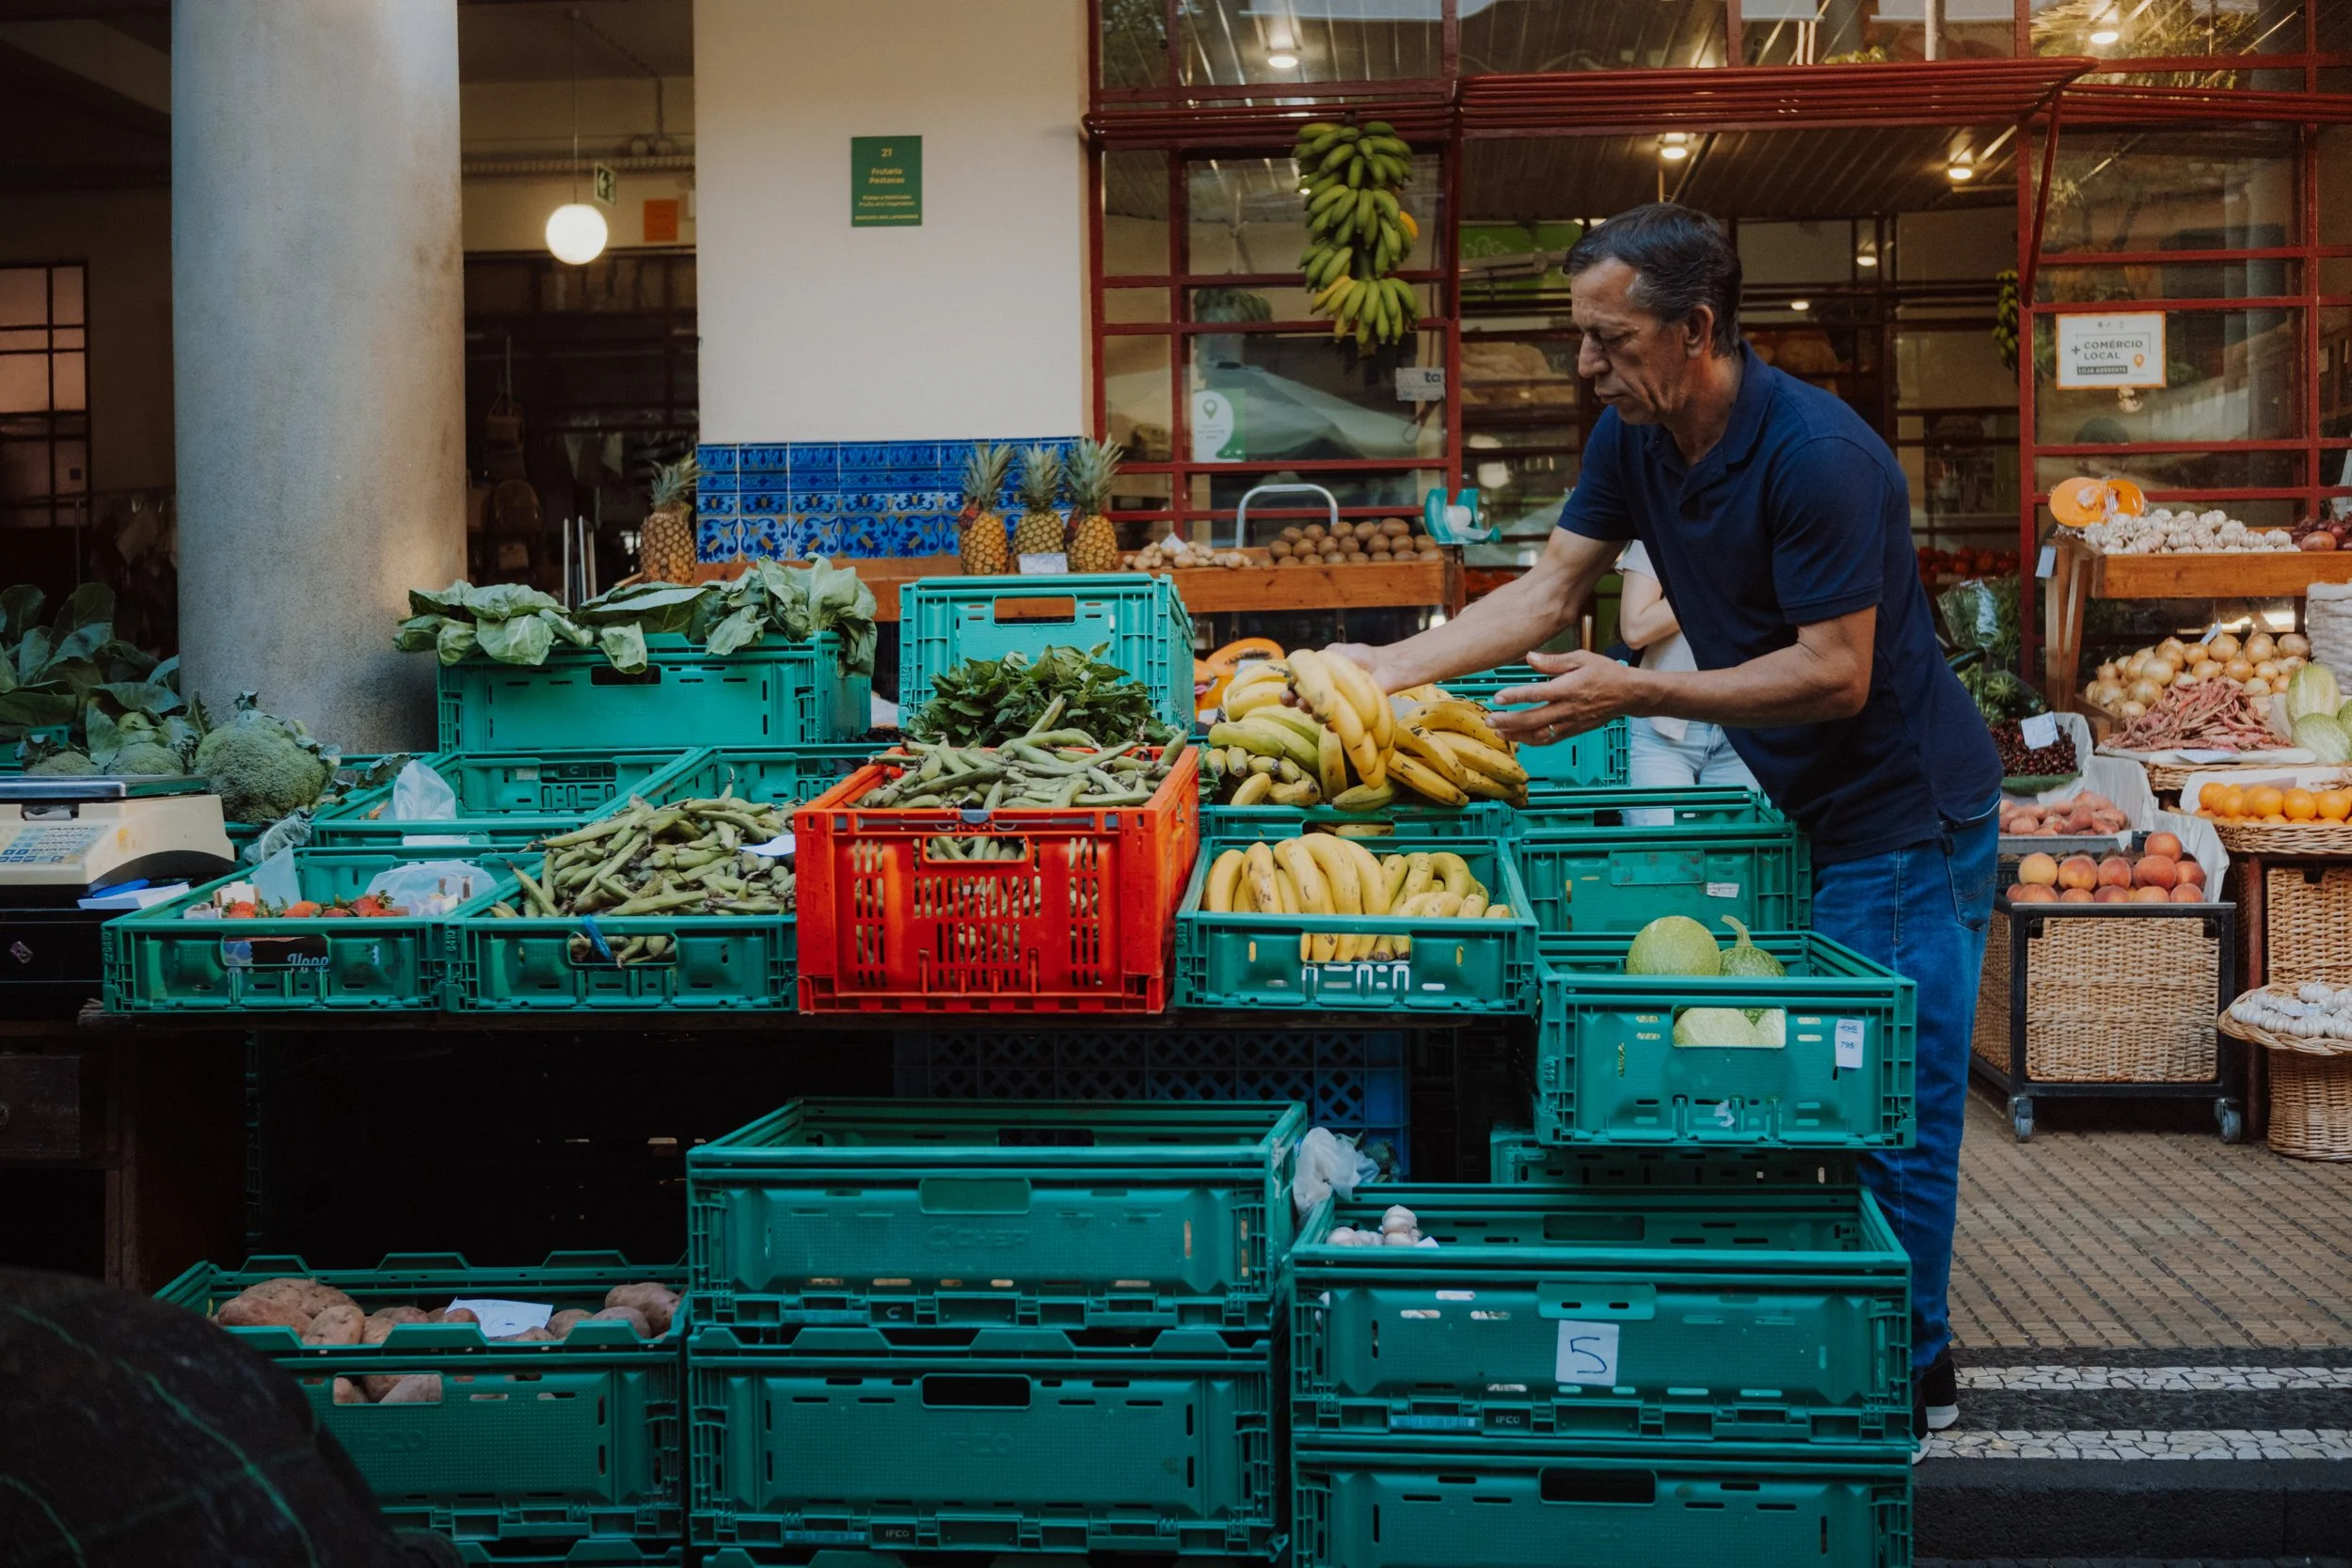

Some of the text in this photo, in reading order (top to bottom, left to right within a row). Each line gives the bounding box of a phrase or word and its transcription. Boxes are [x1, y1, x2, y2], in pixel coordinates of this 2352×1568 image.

[881, 148, 892, 157] 21
[2084, 340, 2143, 350] COMÉRCIO
[2084, 352, 2121, 360] LOCAL
[1570, 1337, 1607, 1374] 5
[1496, 1416, 1520, 1424] IFCO
[885, 1529, 910, 1538] IFCO
